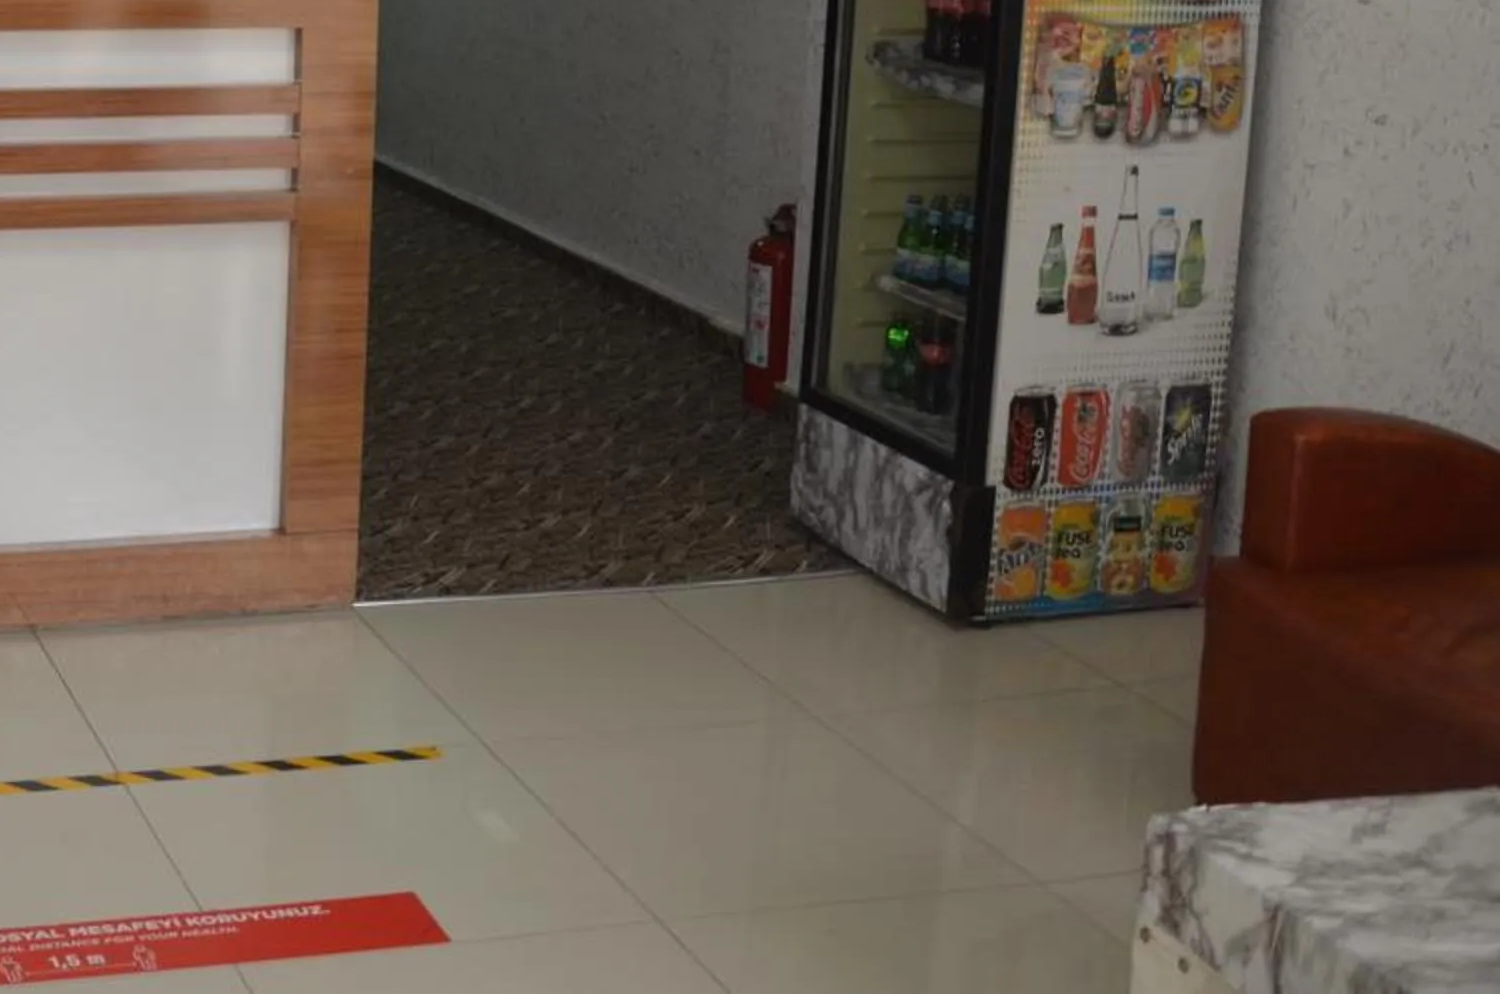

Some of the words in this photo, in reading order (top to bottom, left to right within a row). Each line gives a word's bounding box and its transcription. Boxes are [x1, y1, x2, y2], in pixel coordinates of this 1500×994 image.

[68, 916, 181, 937] MESAFEYİ
[185, 904, 331, 927] KORUYUNUZ.
[29, 937, 100, 952] DISTANCE
[104, 934, 135, 945] FOR
[138, 930, 177, 942] YOUR
[49, 953, 80, 971] 1,5
[86, 953, 106, 966] m
